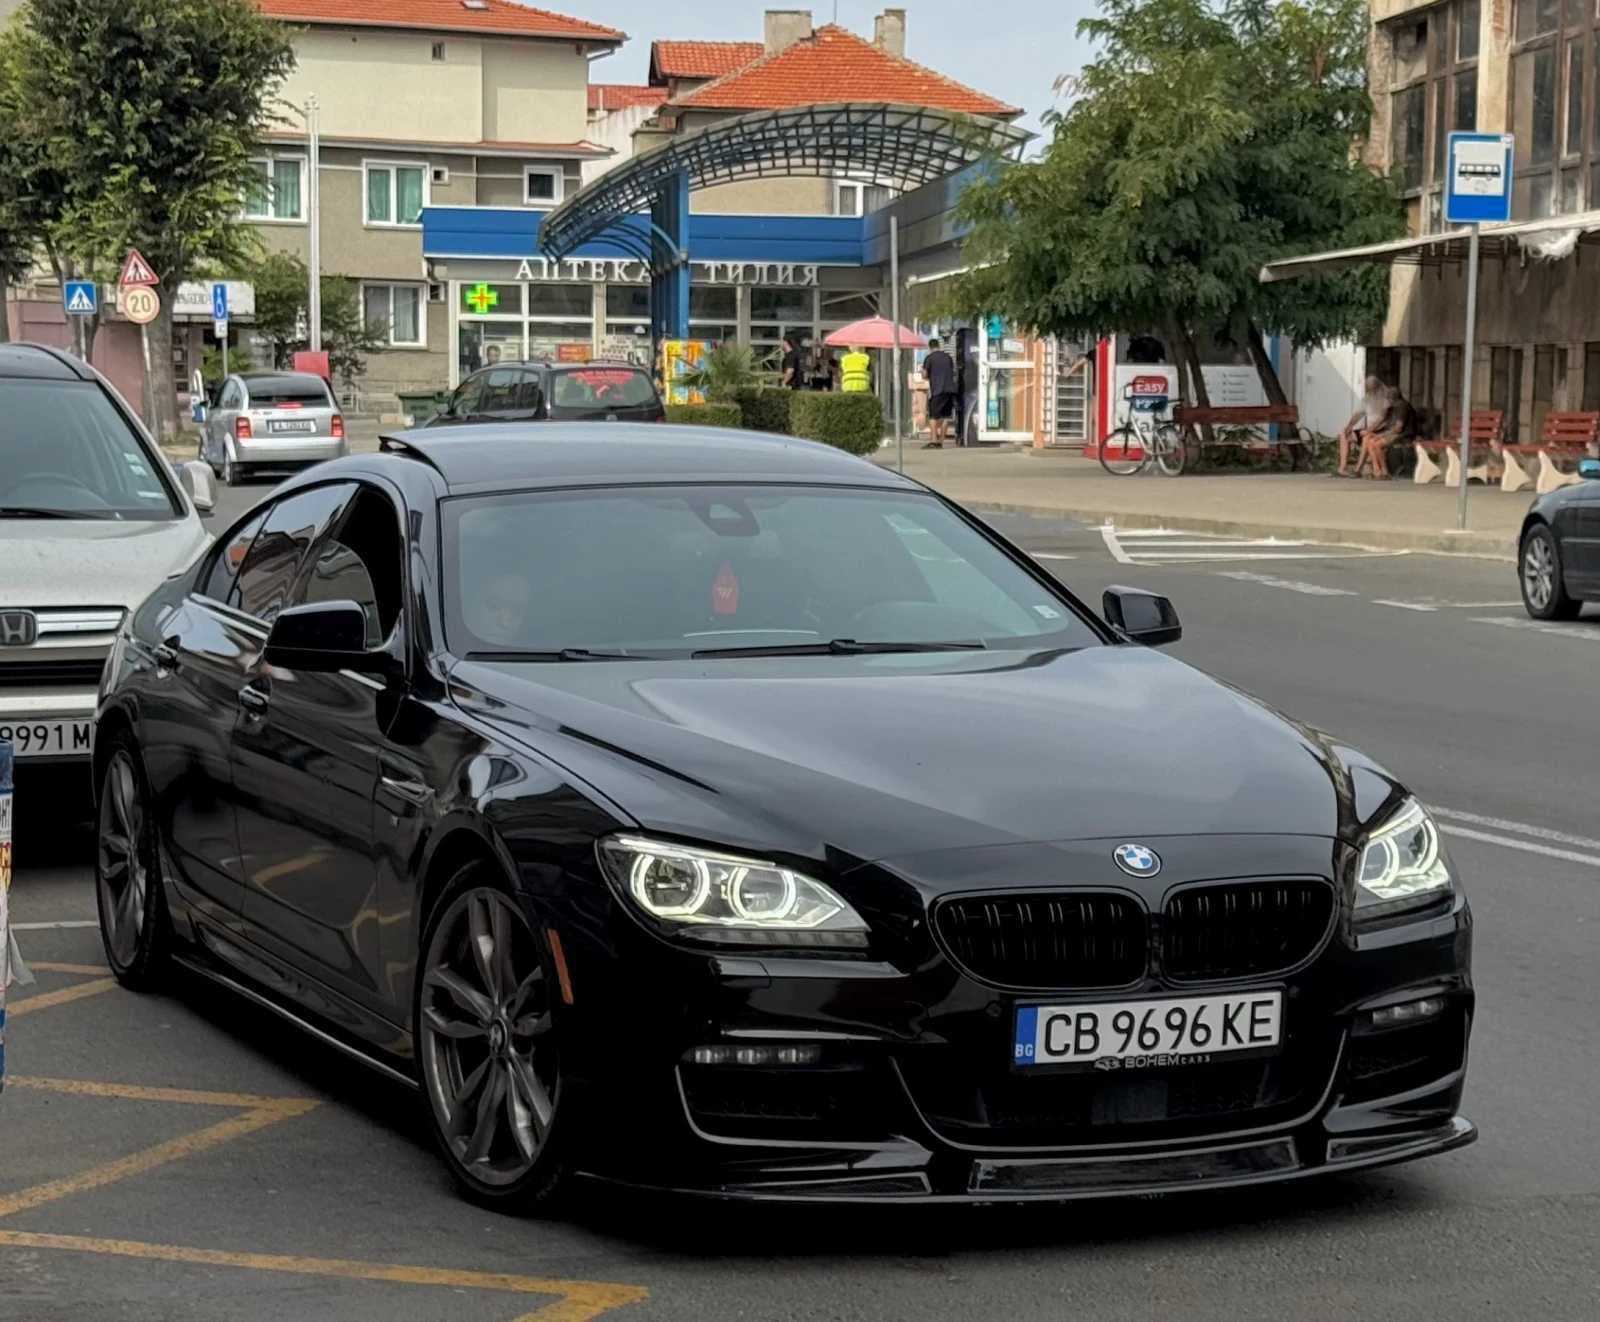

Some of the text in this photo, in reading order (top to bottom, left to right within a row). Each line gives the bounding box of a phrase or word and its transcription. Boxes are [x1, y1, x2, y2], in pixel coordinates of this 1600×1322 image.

[704, 262, 820, 286] ТИЛИЯ
[130, 294, 151, 313] 20
[1135, 380, 1165, 393] Easy
[1044, 999, 1275, 1057] CB 9696 KE
[1015, 1043, 1033, 1058] BG
